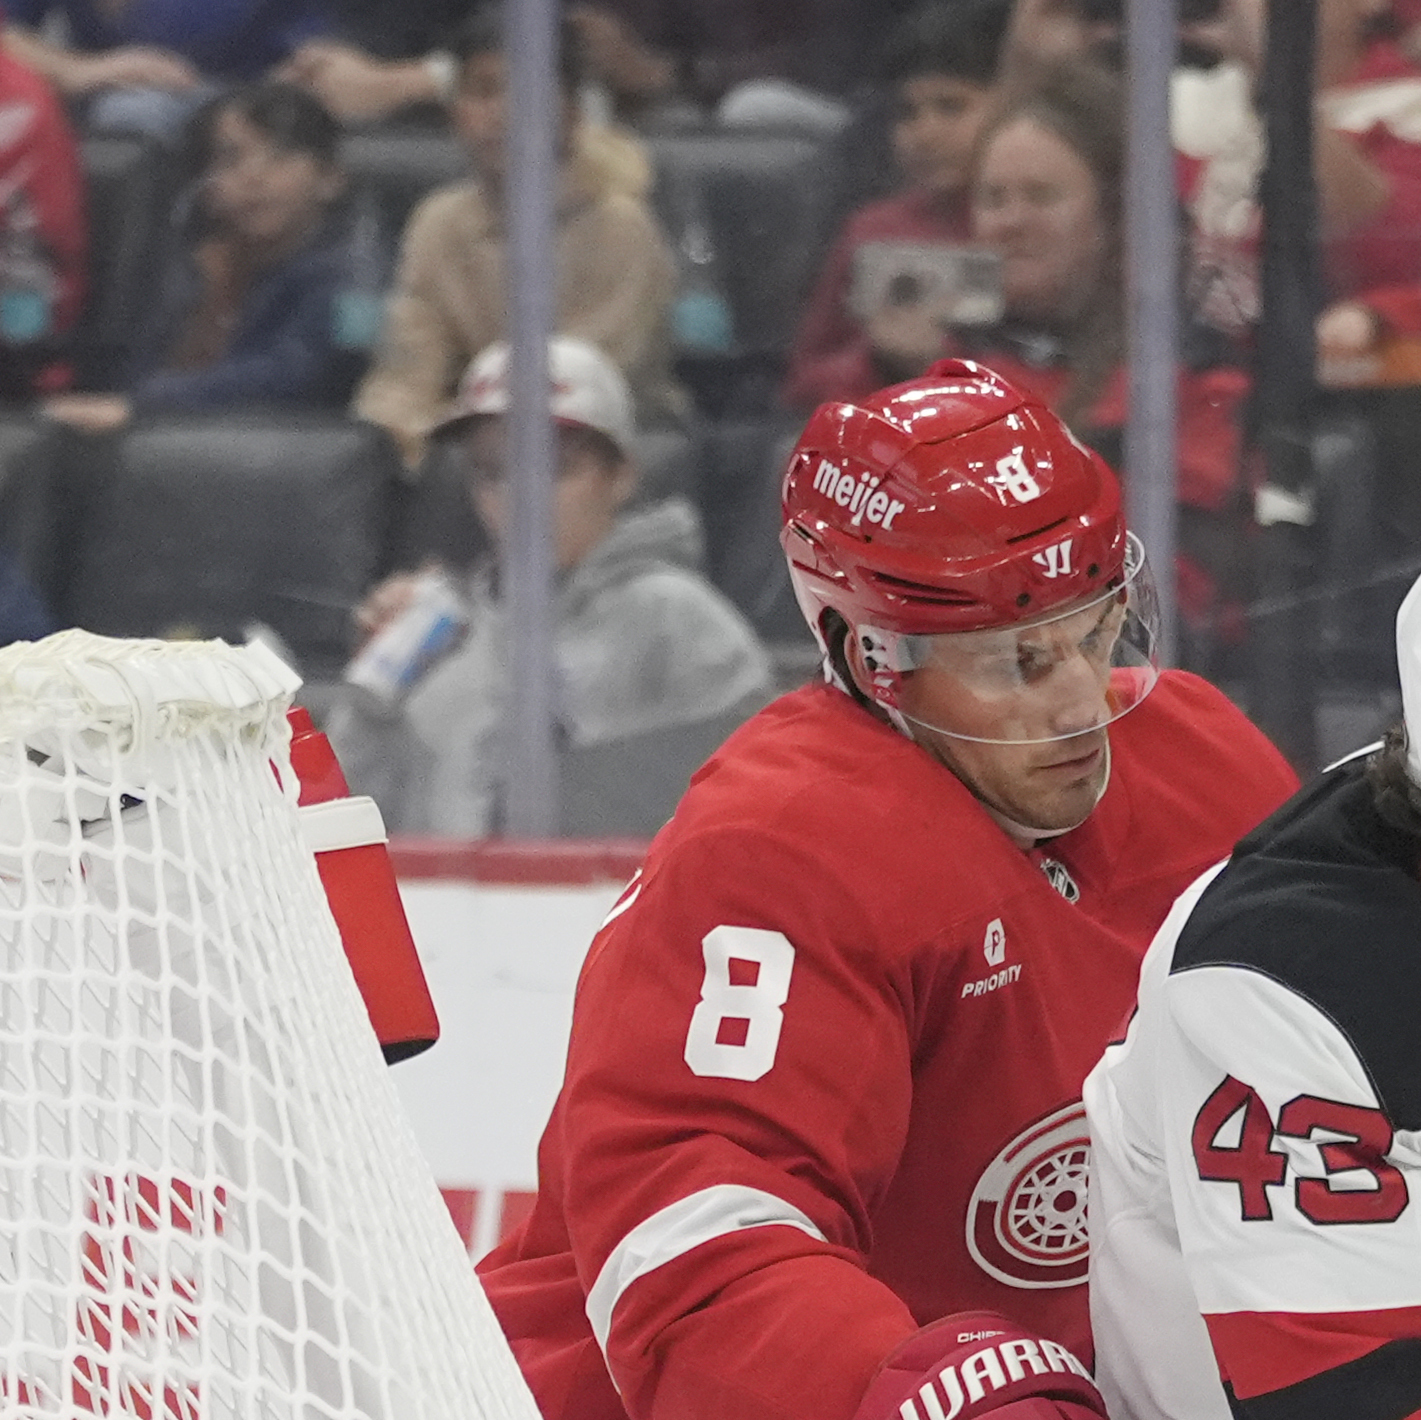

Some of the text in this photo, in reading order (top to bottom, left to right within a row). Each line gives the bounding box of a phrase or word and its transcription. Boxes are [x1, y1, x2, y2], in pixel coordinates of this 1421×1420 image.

[812, 458, 905, 531] meijer
[996, 450, 1041, 504] 8
[683, 925, 796, 1082] 8
[961, 964, 1022, 998] PRIORITY
[1192, 1074, 1409, 1225] 43
